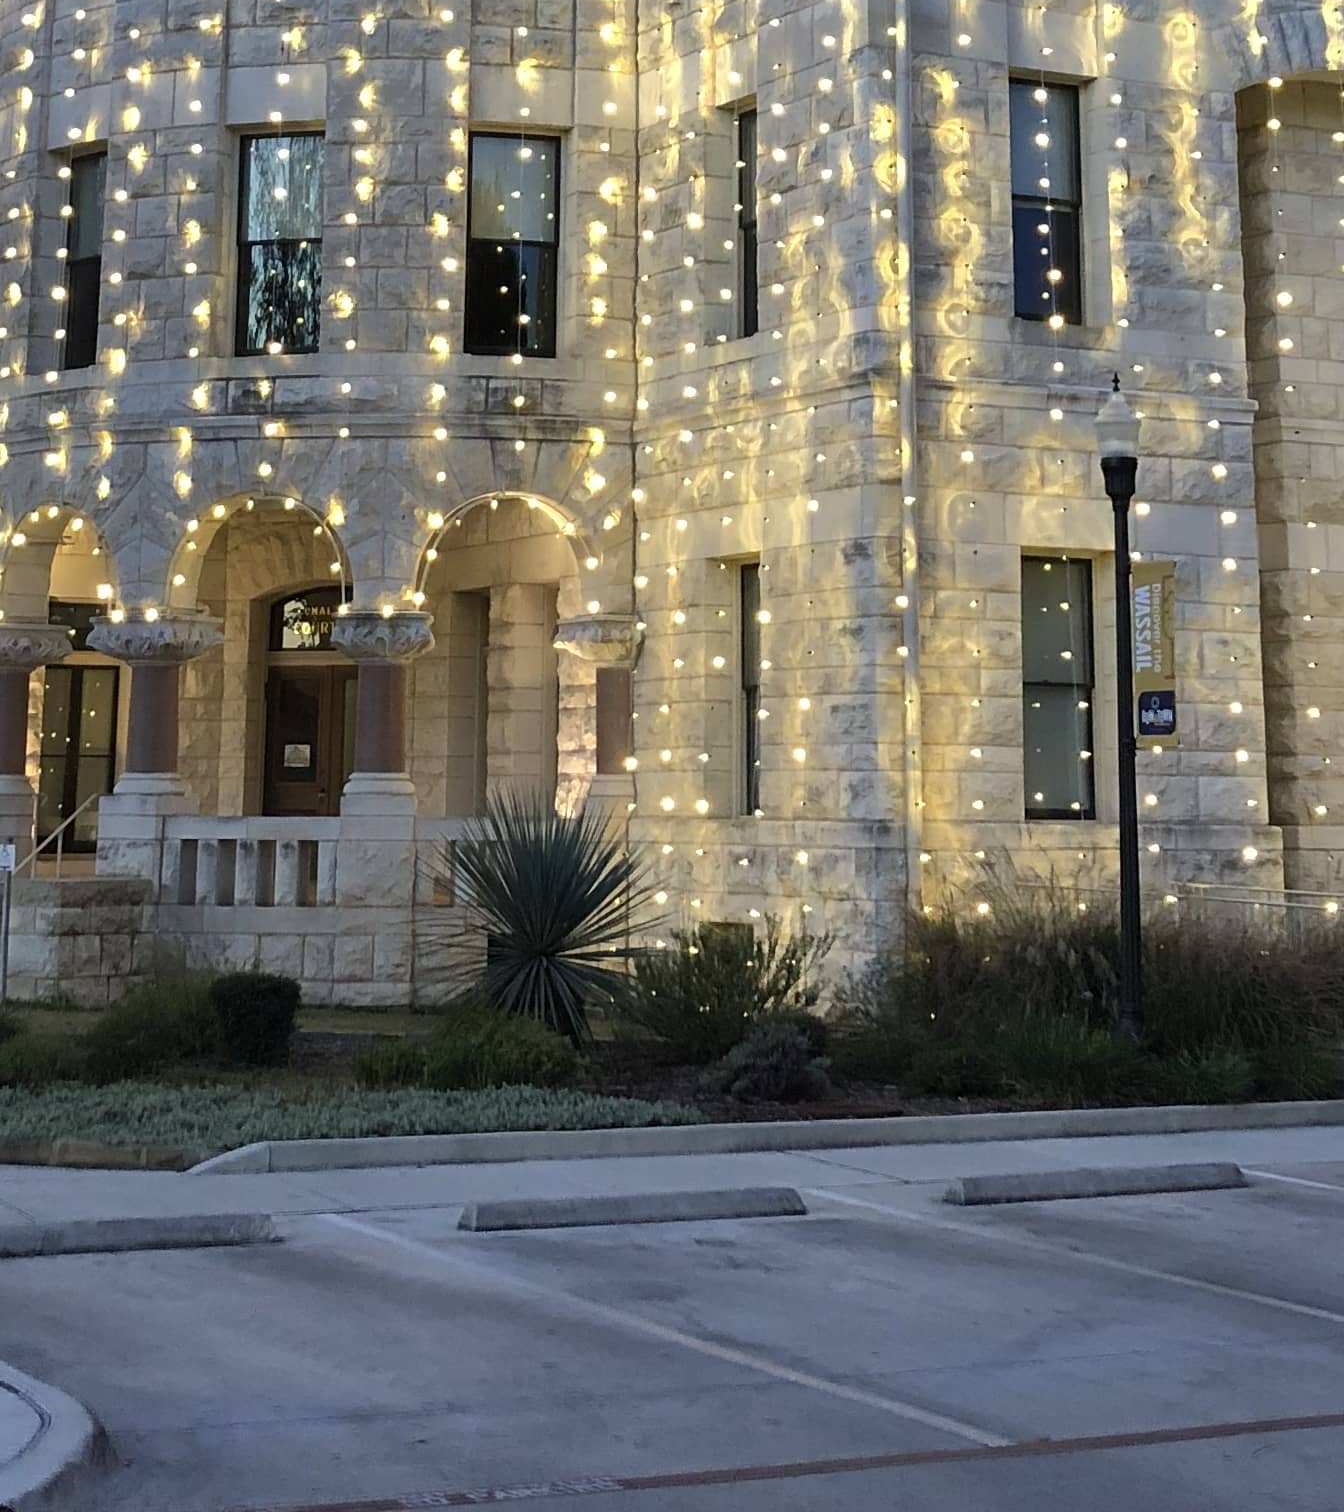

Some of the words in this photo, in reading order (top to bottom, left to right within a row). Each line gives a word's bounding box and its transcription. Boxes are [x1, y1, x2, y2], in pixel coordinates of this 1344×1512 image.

[1135, 585, 1152, 673] WASSAIL
[1152, 583, 1161, 645] Discover
[1153, 649, 1162, 673] the
